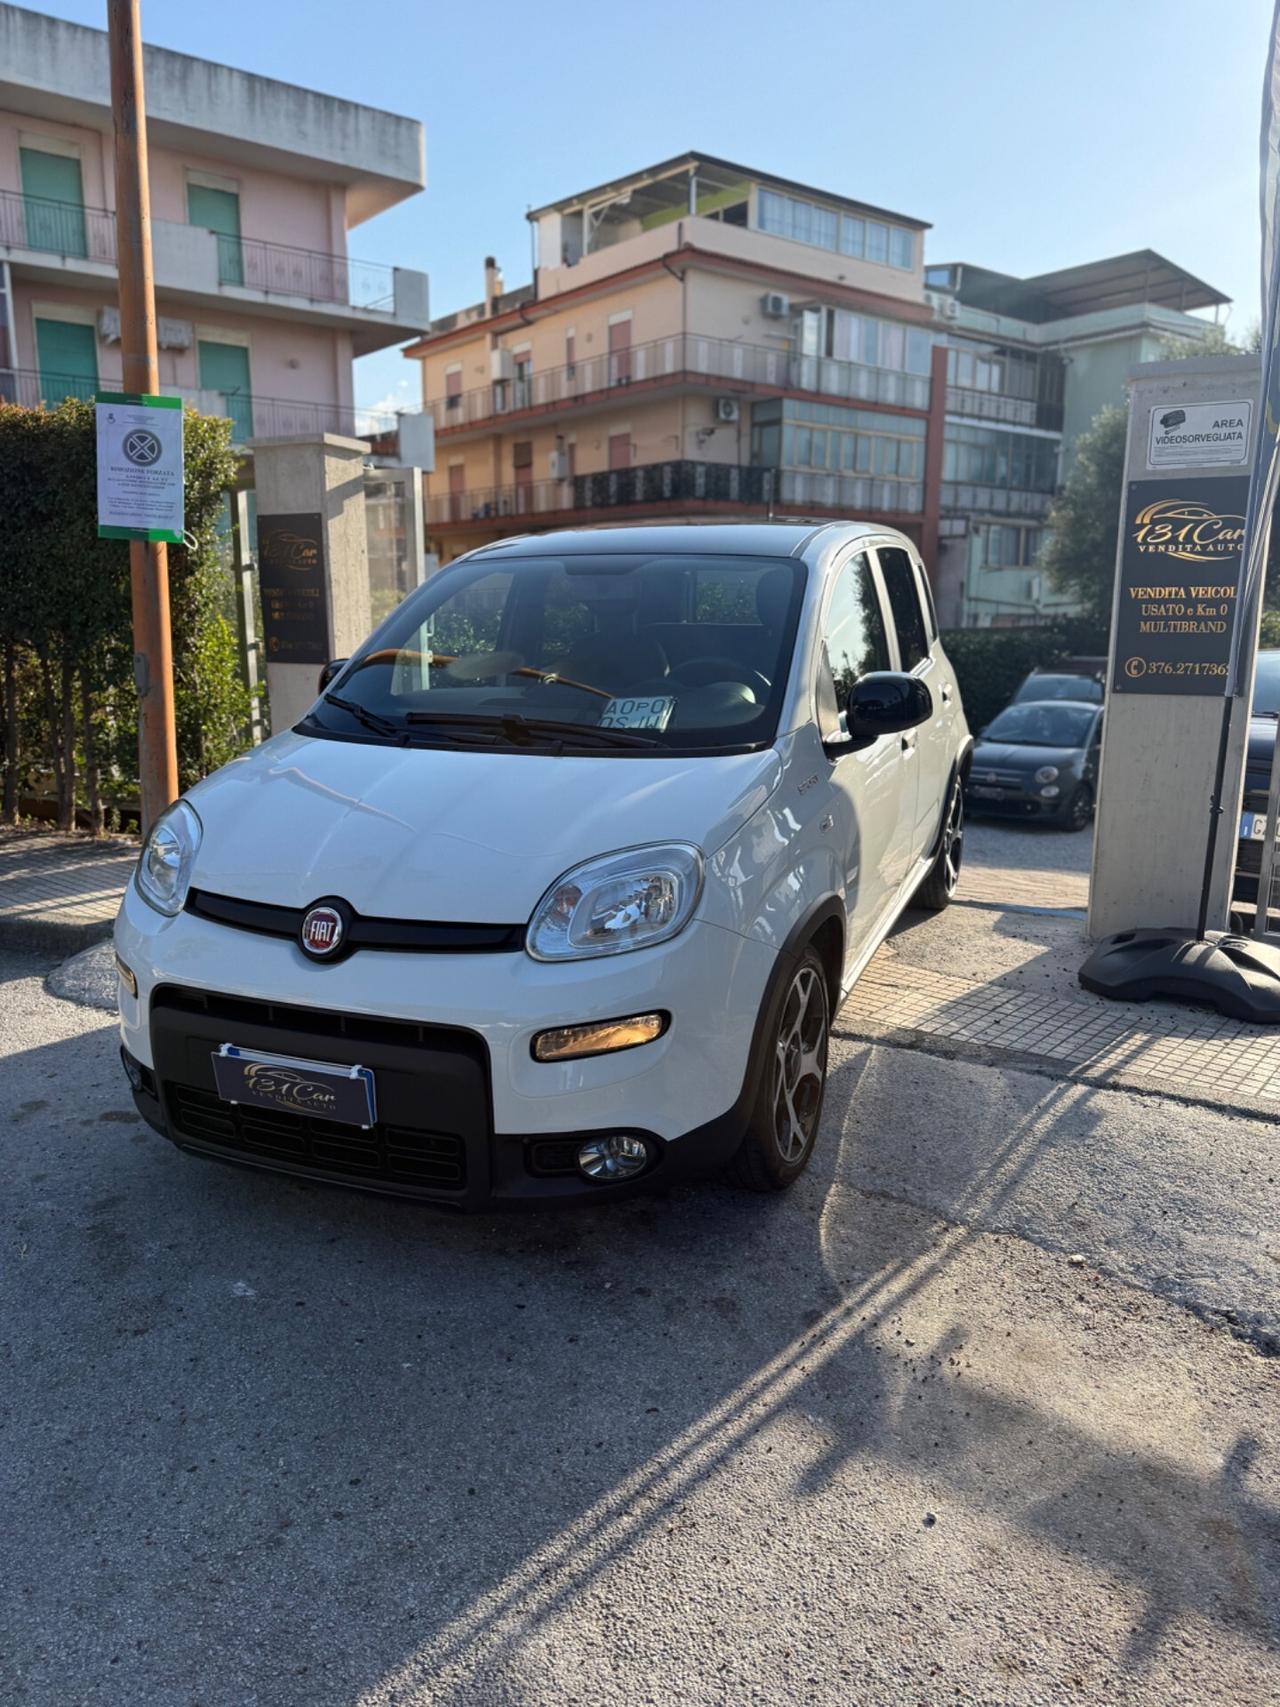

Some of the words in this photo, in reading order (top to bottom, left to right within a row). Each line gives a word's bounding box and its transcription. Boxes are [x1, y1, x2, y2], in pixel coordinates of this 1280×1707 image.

[1212, 418, 1244, 429] AREA
[1155, 431, 1243, 445] VIDEOSORVEGLIATA
[1138, 544, 1202, 553] VENDITA
[1129, 586, 1186, 599] VENDITA
[1141, 604, 1184, 616] USATO
[1196, 603, 1217, 616] Km
[1139, 620, 1227, 633] MULTIBRAND
[310, 920, 335, 941] FIAT
